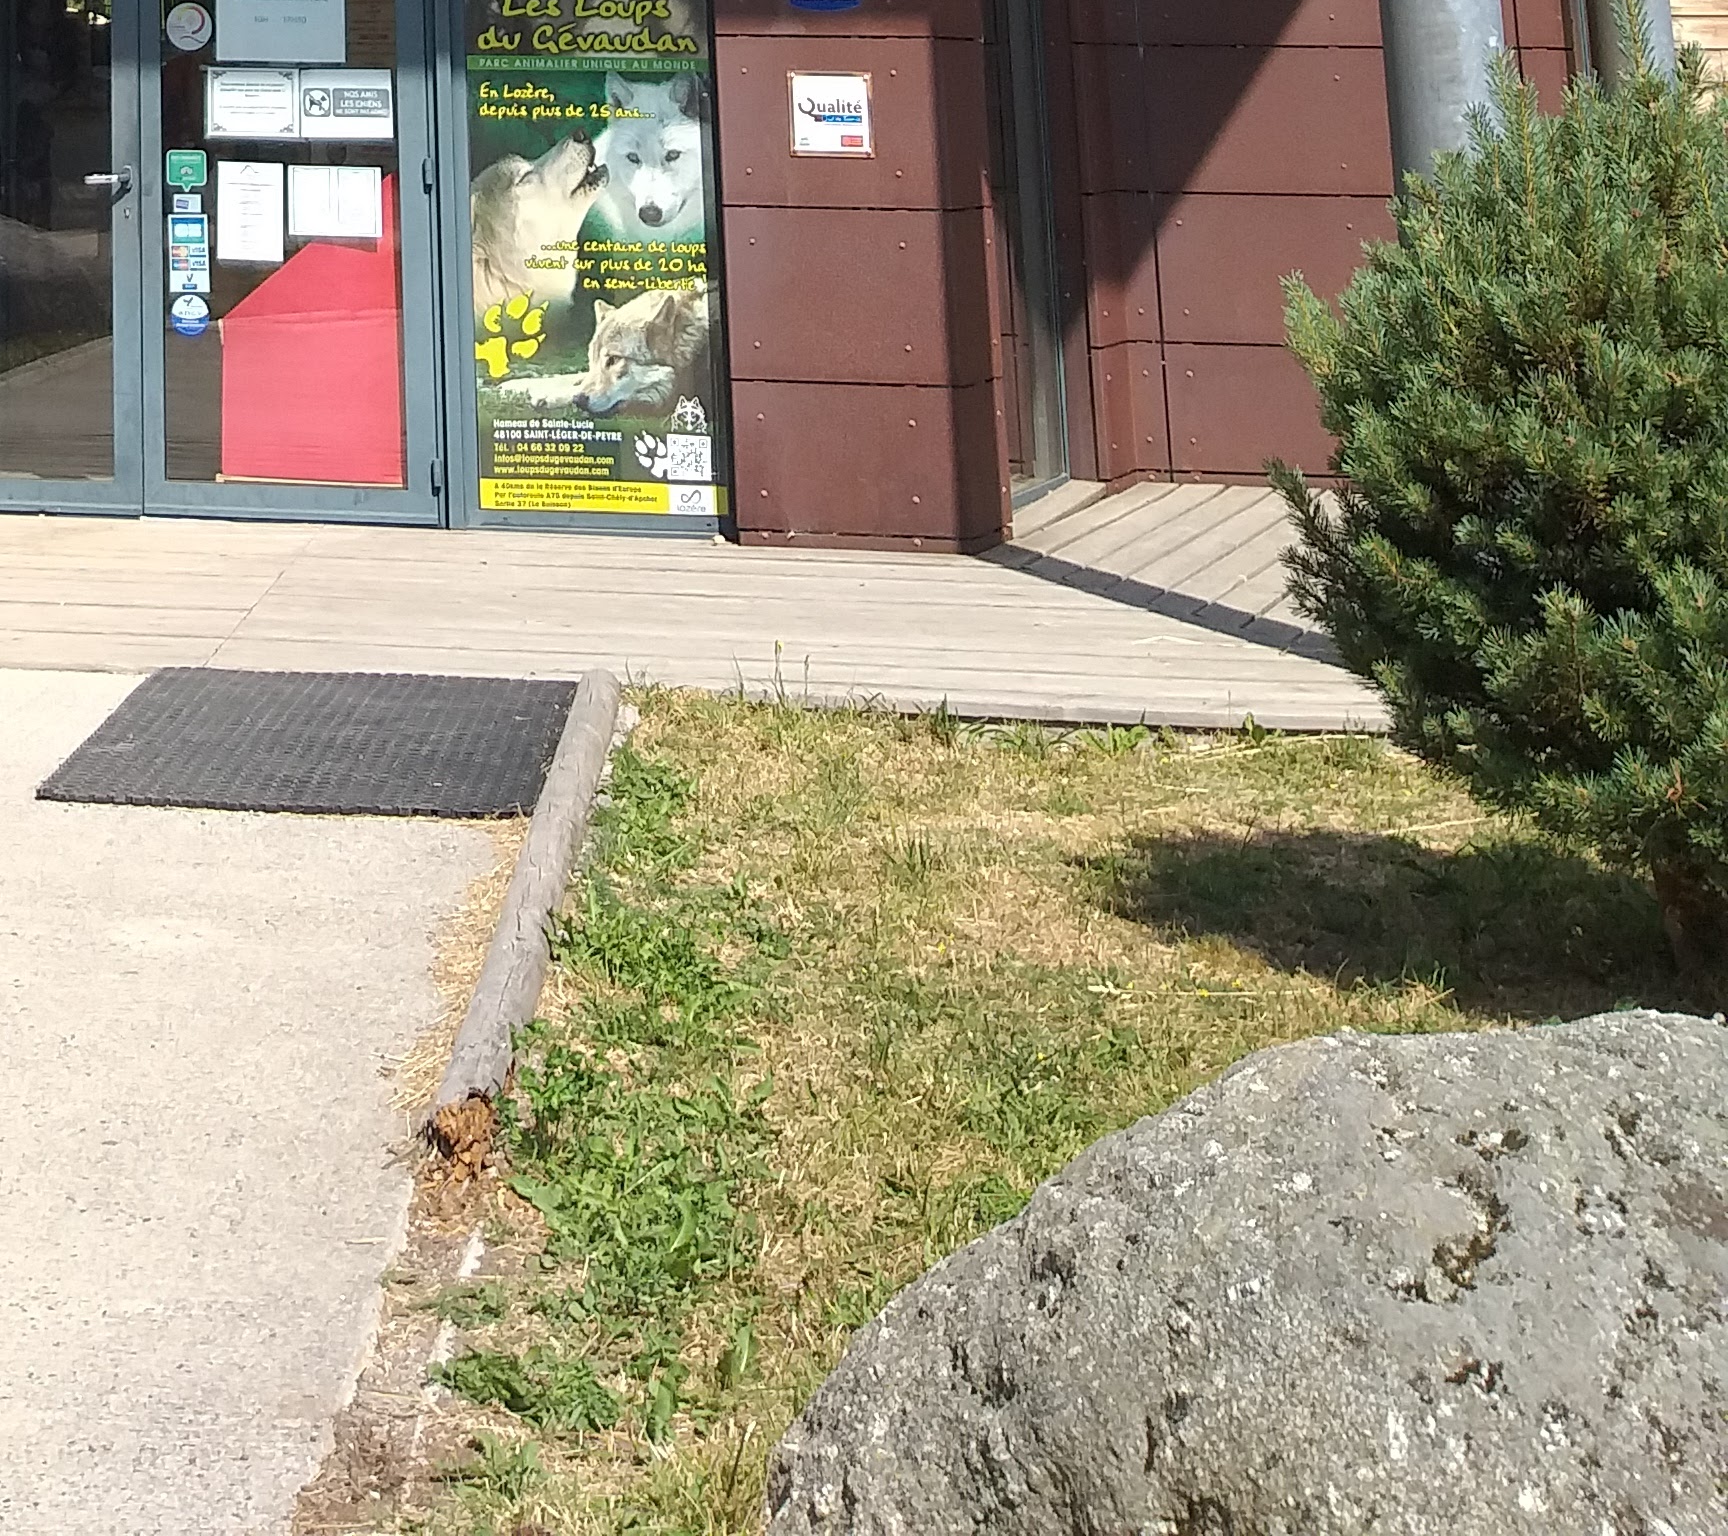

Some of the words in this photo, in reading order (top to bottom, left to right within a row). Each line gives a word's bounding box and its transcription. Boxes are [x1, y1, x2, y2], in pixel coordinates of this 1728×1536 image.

[477, 26, 521, 50] du
[532, 22, 697, 54] Gévaudan
[479, 59, 509, 68] PARC
[514, 59, 578, 68] ANIMALIER
[582, 59, 627, 70] UNIQUE
[632, 60, 648, 69] AU
[652, 60, 696, 70] MONDE
[344, 90, 358, 99] NOS
[480, 81, 498, 98] En
[503, 83, 555, 102] Lozère,
[340, 99, 354, 108] LES
[798, 97, 862, 115] Qualité
[479, 103, 527, 119] depuis
[532, 104, 561, 120] plus
[565, 104, 584, 117] de
[590, 104, 610, 118] 25
[616, 108, 656, 119] ans...
[541, 241, 579, 253] ...une
[583, 241, 644, 253] centaine
[647, 241, 666, 253] de
[671, 242, 706, 256] loups
[525, 258, 567, 270] vivent
[573, 260, 595, 270] sur
[600, 258, 629, 273] plus
[634, 258, 653, 270] de
[658, 258, 683, 272] 20
[687, 260, 706, 273] ha
[583, 280, 599, 289] en
[603, 276, 696, 291] semi-liberté
[493, 419, 528, 428] Hameau
[529, 420, 540, 428] de
[542, 419, 594, 429] Sainte-Lucie
[494, 430, 522, 439] 48100
[524, 429, 622, 441] SAINT-LÉGER-DE-PEYRE
[516, 443, 529, 452] 04
[530, 443, 543, 452] 66
[544, 443, 557, 453] 32
[558, 444, 571, 453] 09
[572, 444, 584, 453] 22
